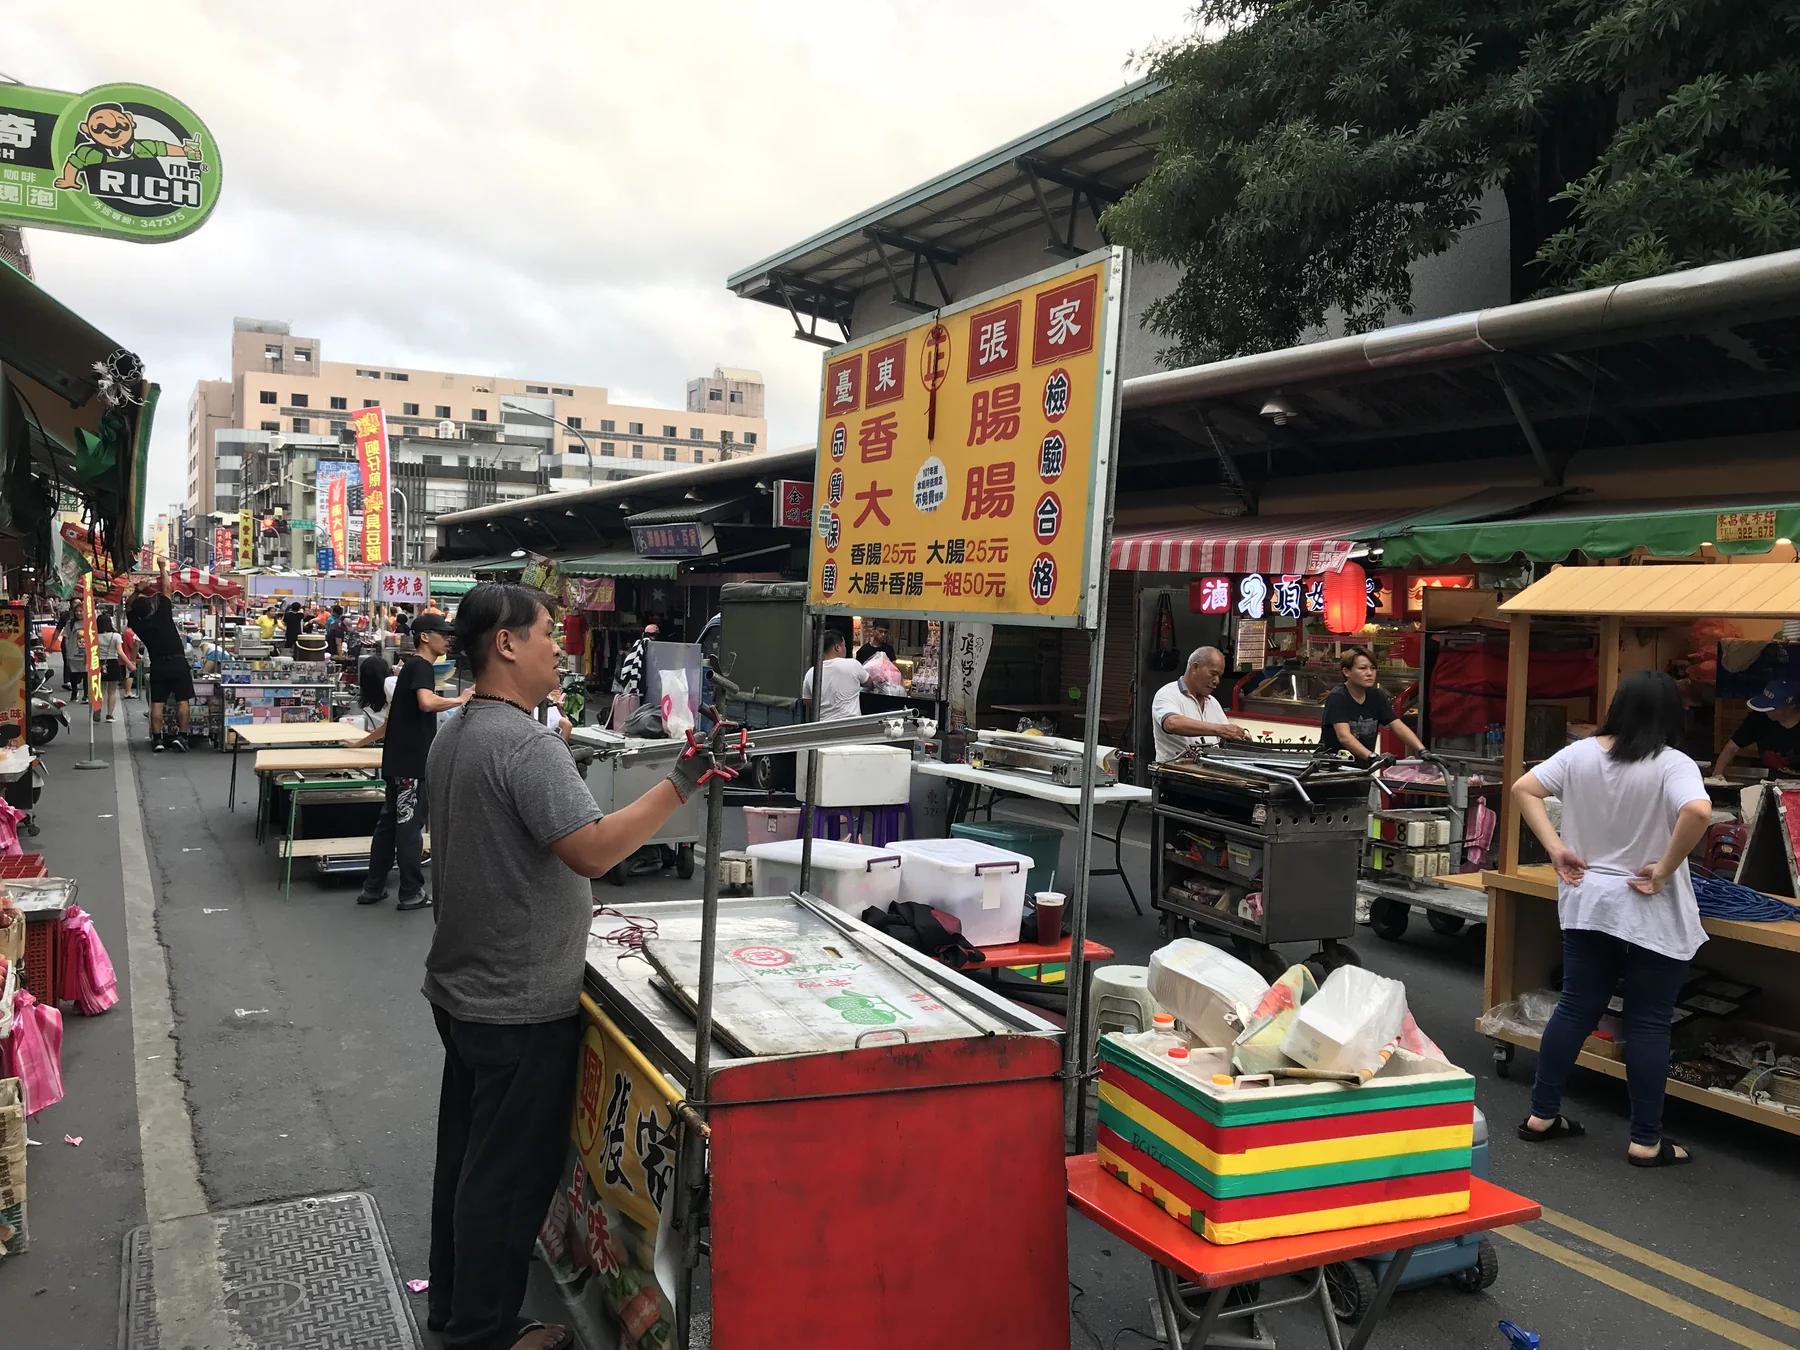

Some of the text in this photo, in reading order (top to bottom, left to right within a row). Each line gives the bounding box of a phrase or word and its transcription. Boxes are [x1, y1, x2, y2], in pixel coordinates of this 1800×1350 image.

[0, 148, 15, 160] H
[4, 169, 37, 183] 咖啡
[100, 169, 199, 207] RICH
[141, 212, 185, 228] 347375
[979, 297, 1082, 367] 張家
[1030, 375, 1069, 601] 檢驗合格
[822, 427, 846, 596] 品質保證
[850, 537, 1009, 566] 香腸25元 大腸25元
[383, 575, 423, 597] 烤魷魚
[847, 571, 1007, 598] 大腸+香腸一組50元
[1202, 579, 1229, 611] 滷
[1397, 823, 1407, 842] 8
[1385, 852, 1396, 868] 5
